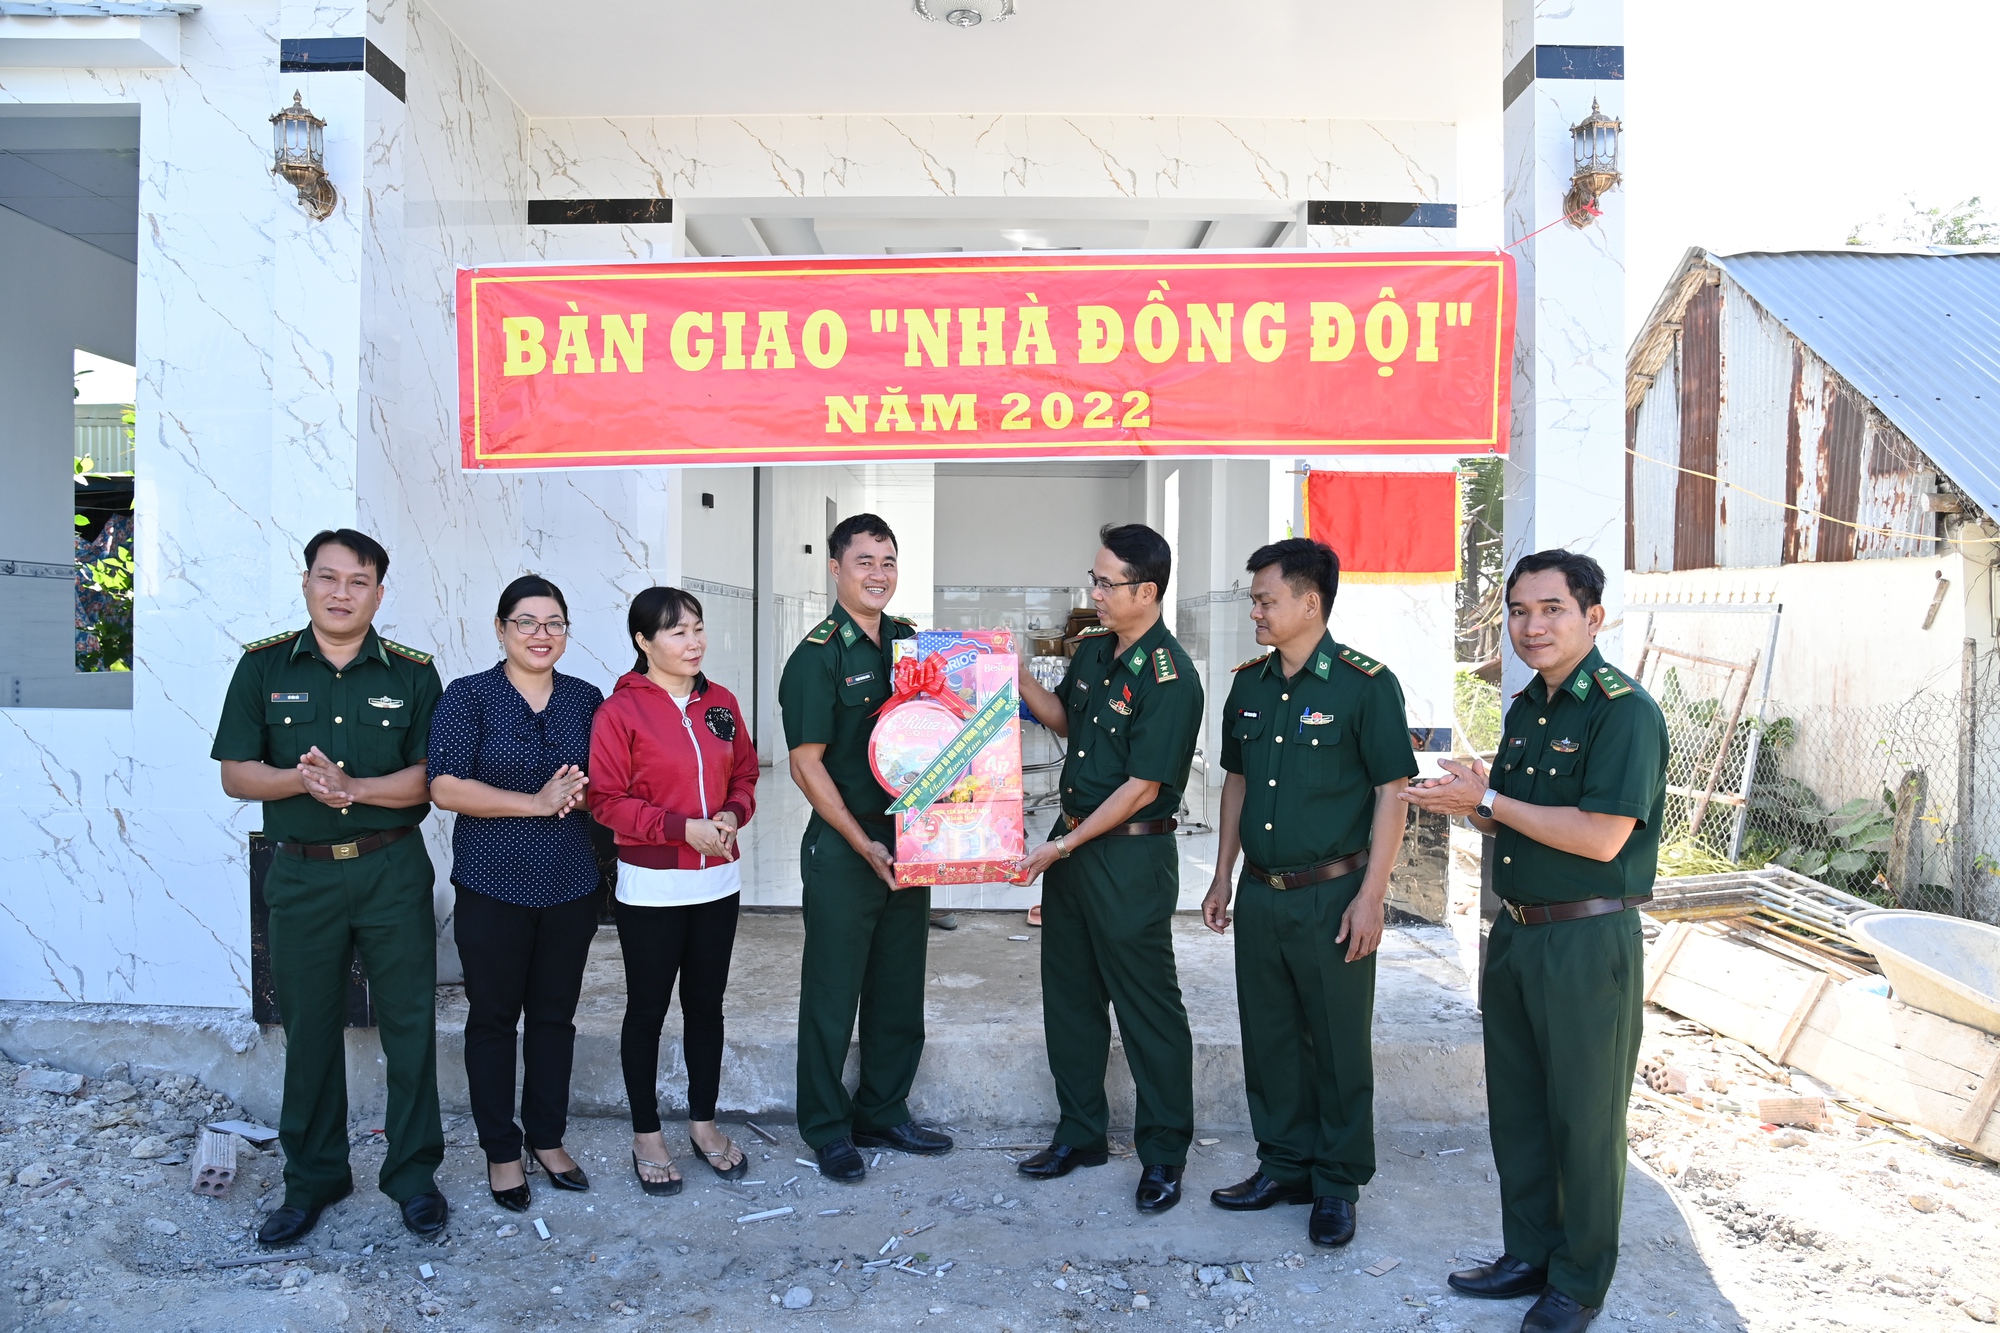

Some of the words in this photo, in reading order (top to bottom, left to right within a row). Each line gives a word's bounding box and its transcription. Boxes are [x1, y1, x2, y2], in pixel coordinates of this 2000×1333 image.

[503, 301, 647, 376] BÀN
[670, 310, 847, 371] GIAO
[871, 293, 1056, 367] "NHÀ
[1078, 280, 1286, 363] ĐỒNG
[1310, 287, 1472, 377] ĐỘI"
[825, 387, 977, 433] NĂM
[1001, 391, 1149, 429] 2022
